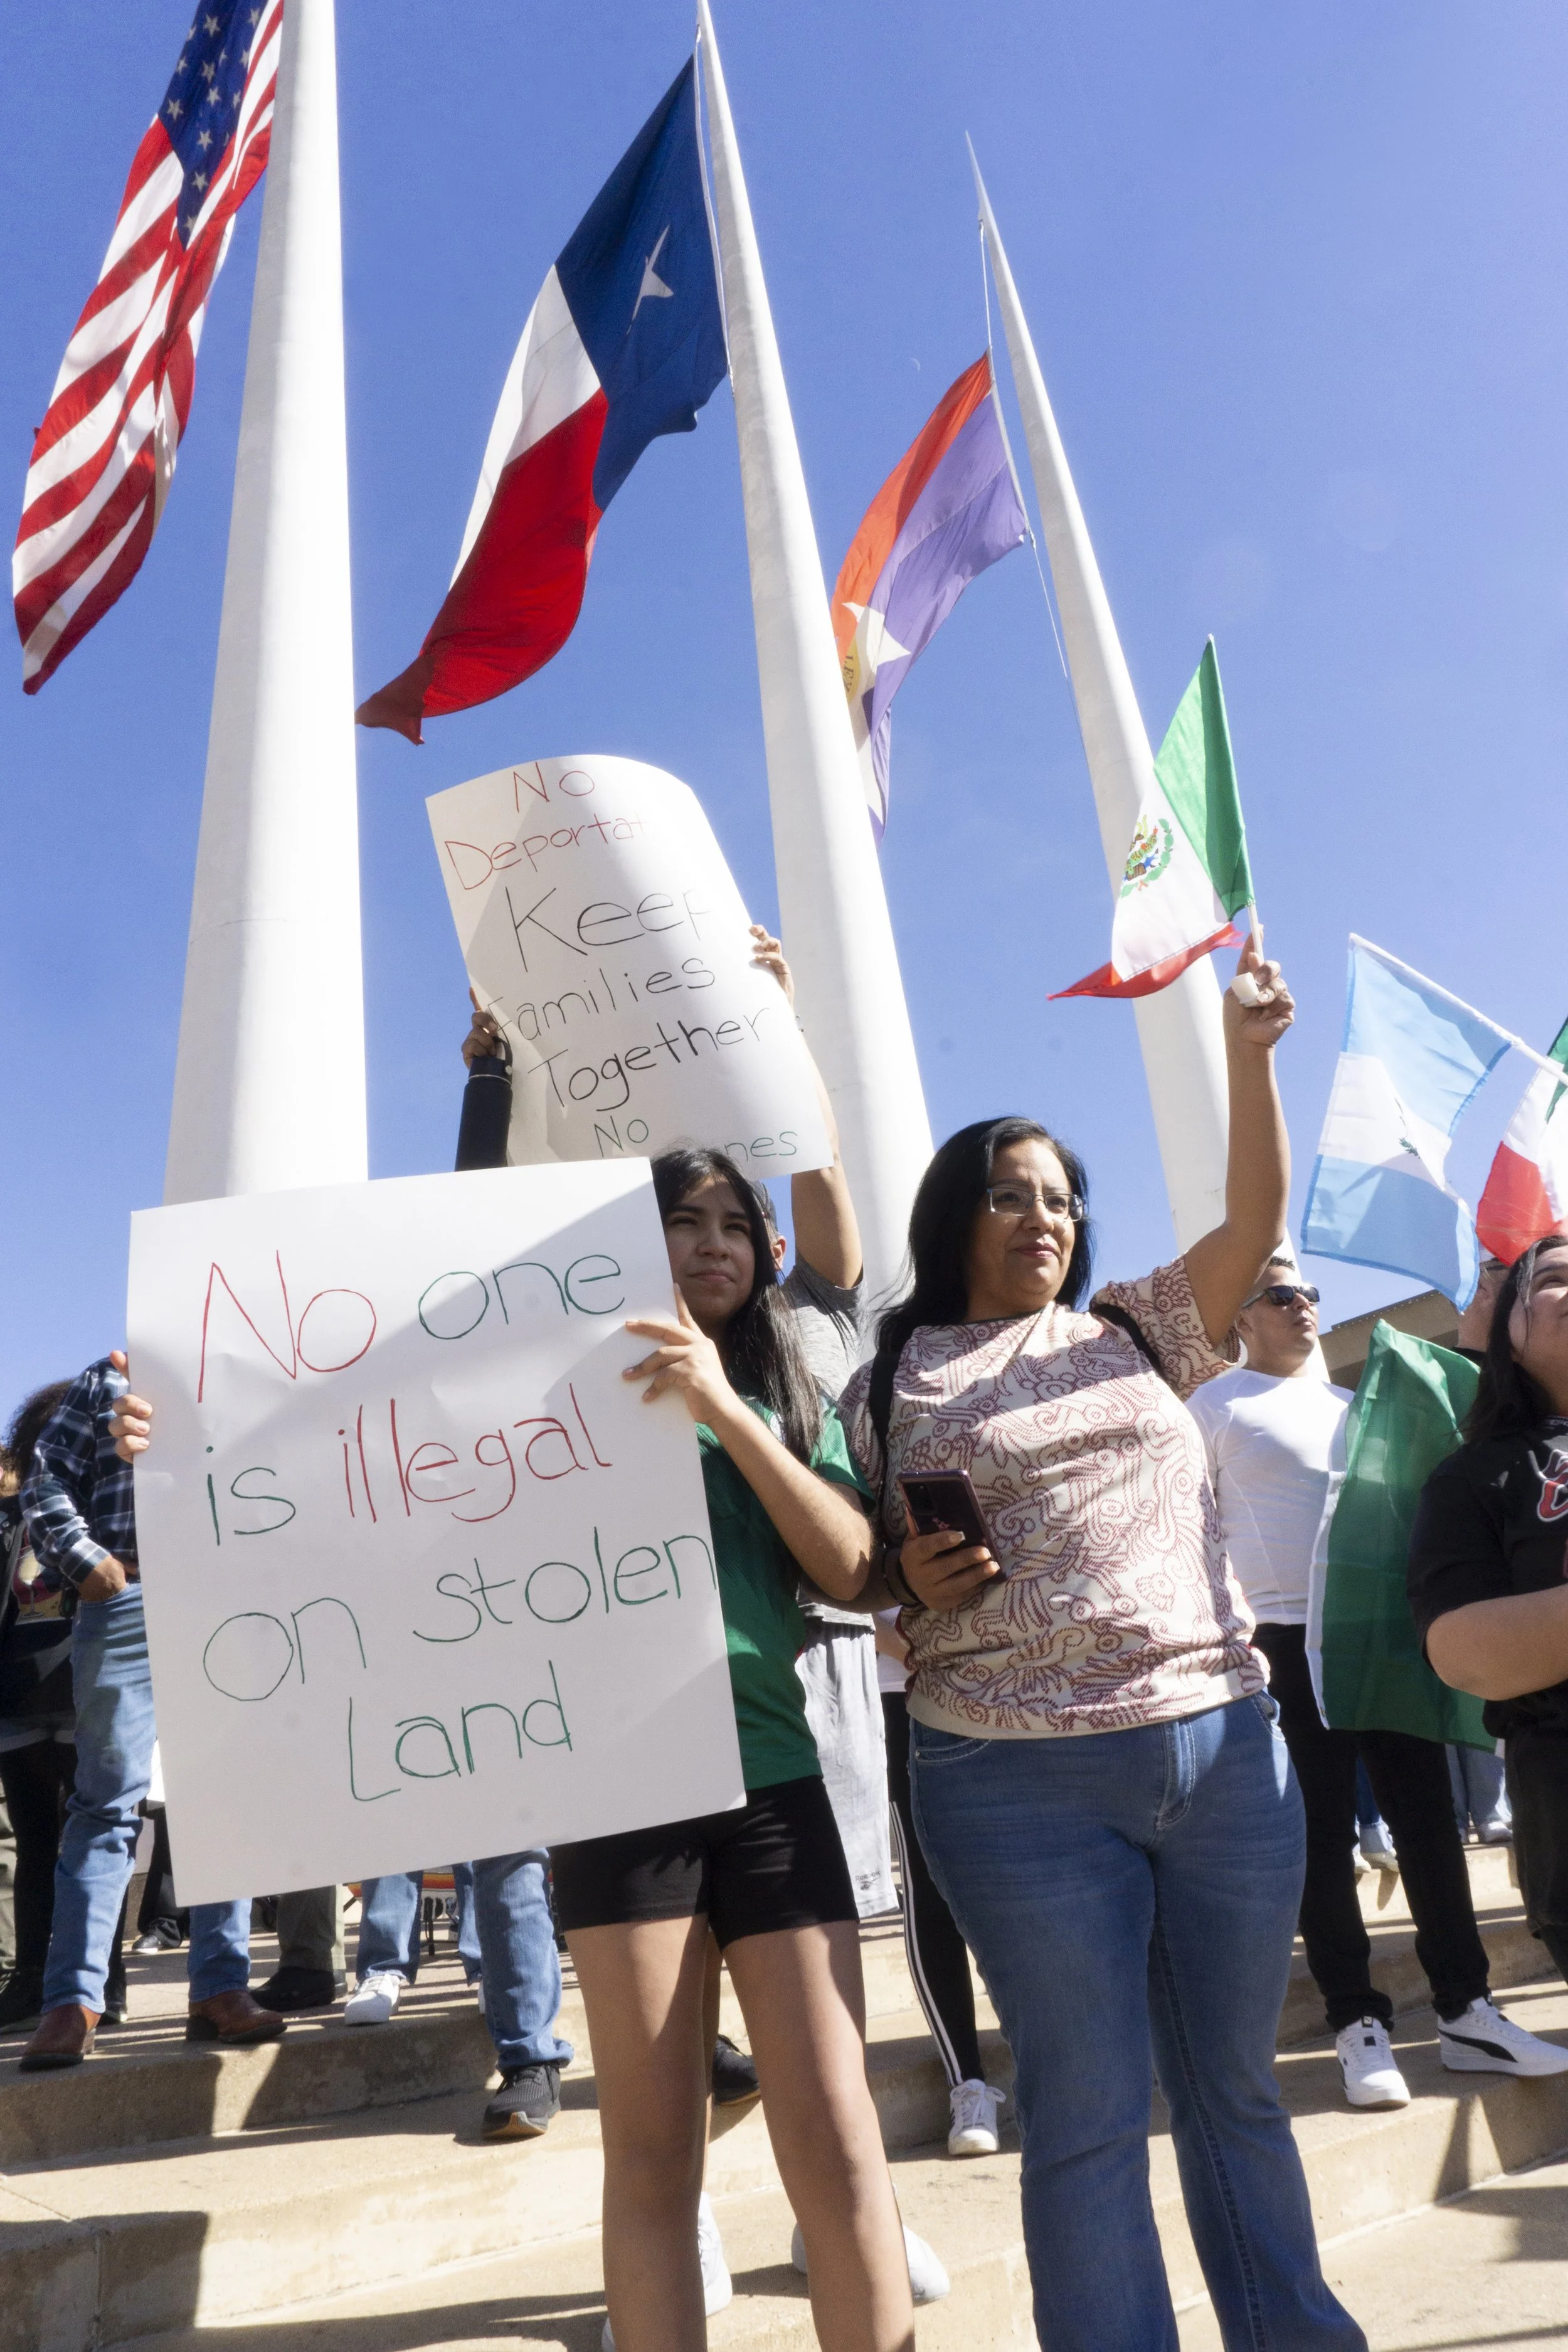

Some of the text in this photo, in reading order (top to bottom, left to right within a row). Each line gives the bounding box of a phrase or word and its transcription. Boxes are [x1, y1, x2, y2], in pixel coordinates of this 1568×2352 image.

[513, 761, 595, 813] No
[444, 811, 650, 891] Deportat
[486, 958, 716, 1041] Families
[527, 1007, 770, 1112] Together
[594, 1115, 649, 1158] No
[198, 1249, 625, 1404] No one
[205, 1382, 613, 1547] is illegal
[203, 1527, 717, 1702] on stolen
[348, 1660, 573, 1802] Land
